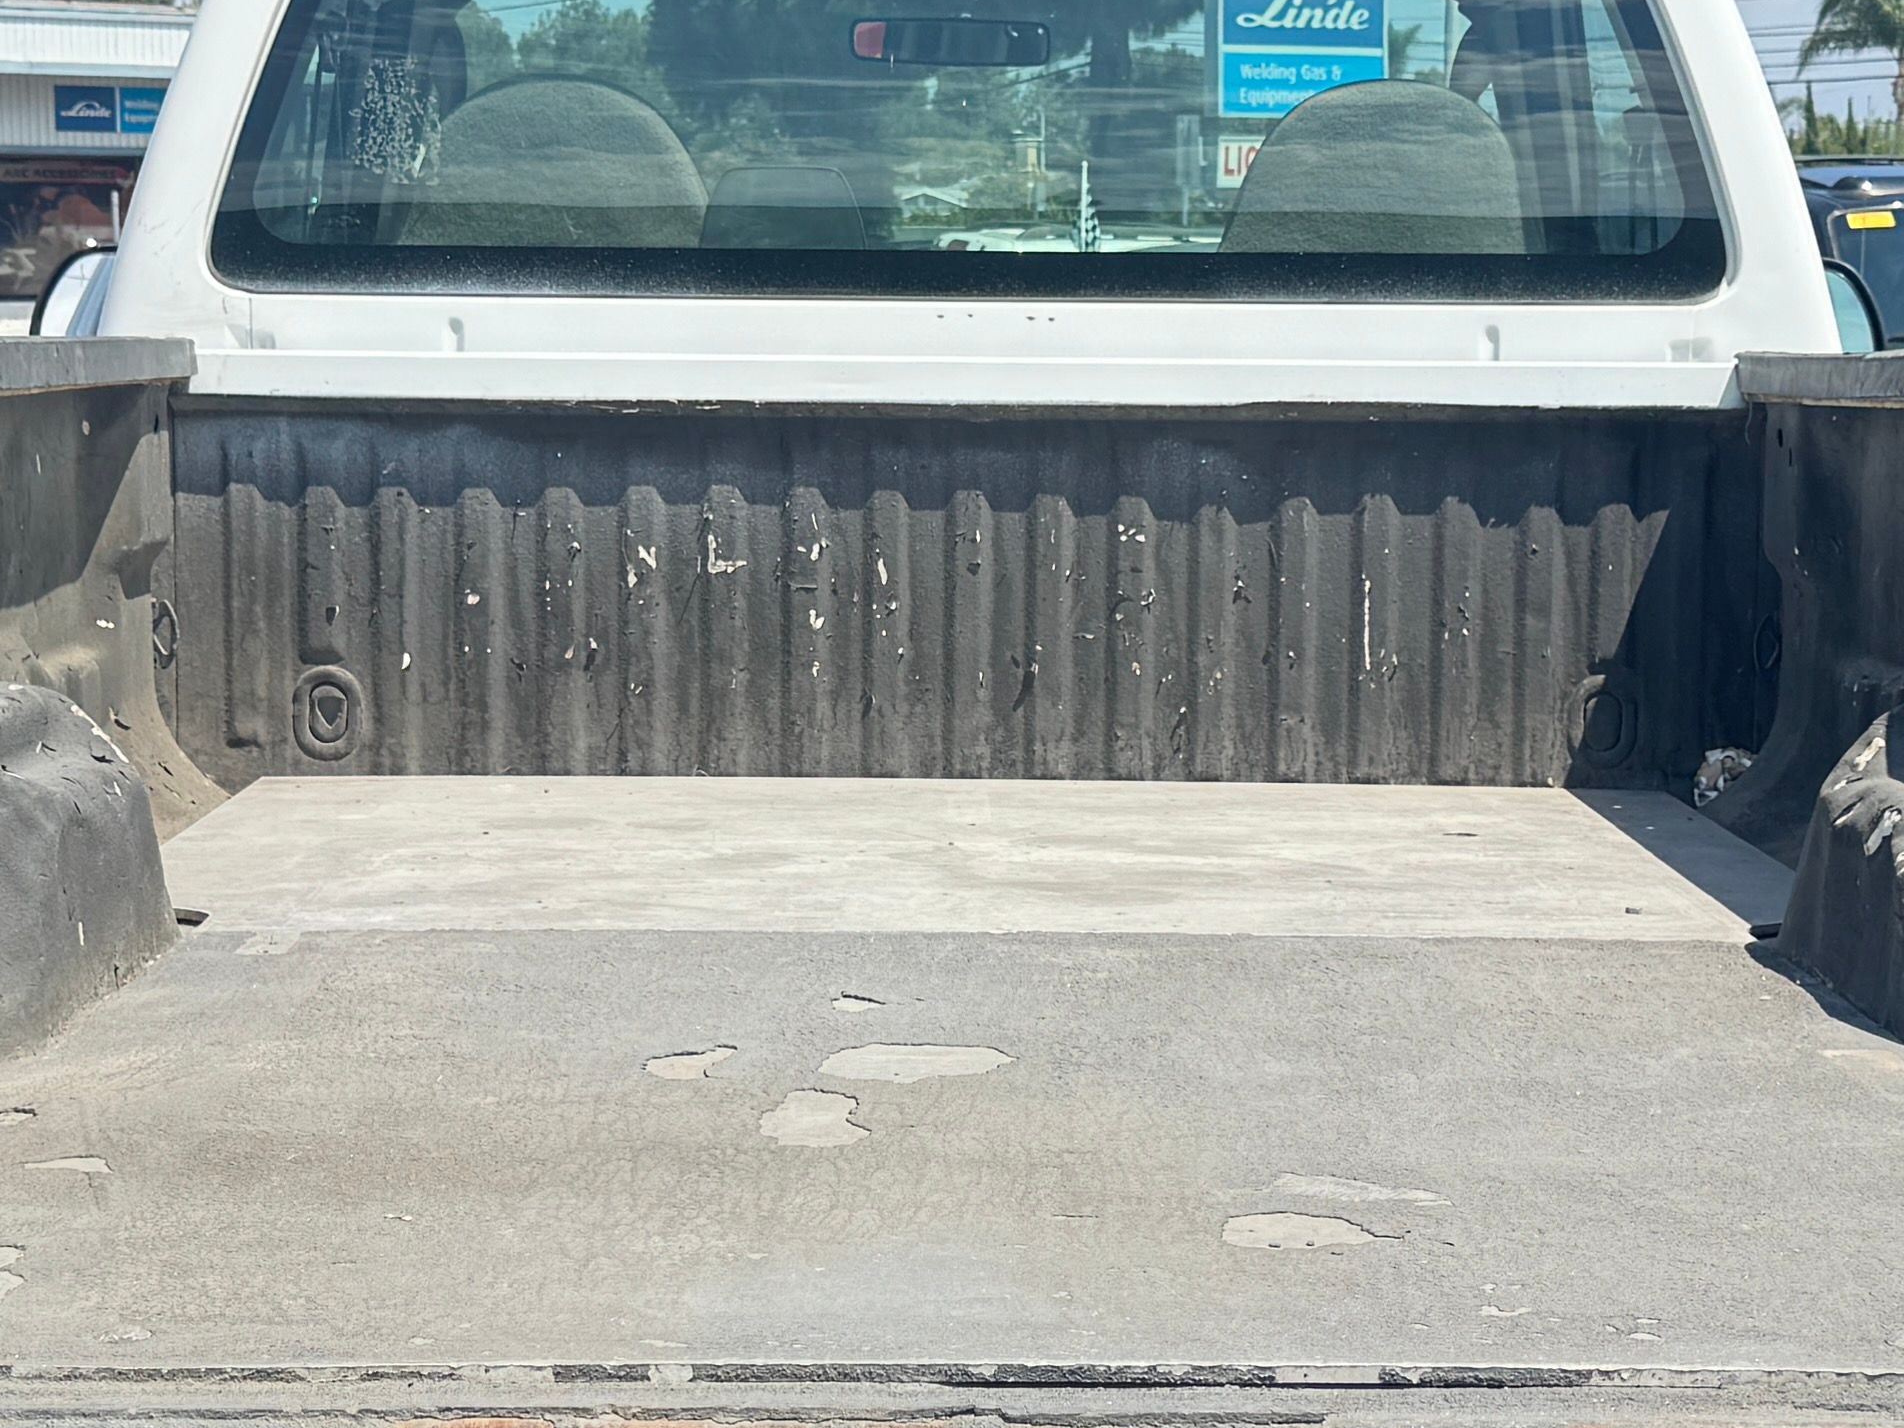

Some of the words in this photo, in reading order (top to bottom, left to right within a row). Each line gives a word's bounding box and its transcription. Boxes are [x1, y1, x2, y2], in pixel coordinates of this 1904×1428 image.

[1240, 63, 1297, 84] Welding
[1300, 64, 1327, 81] Gas
[1331, 65, 1342, 81] &
[60, 99, 112, 118] Linde
